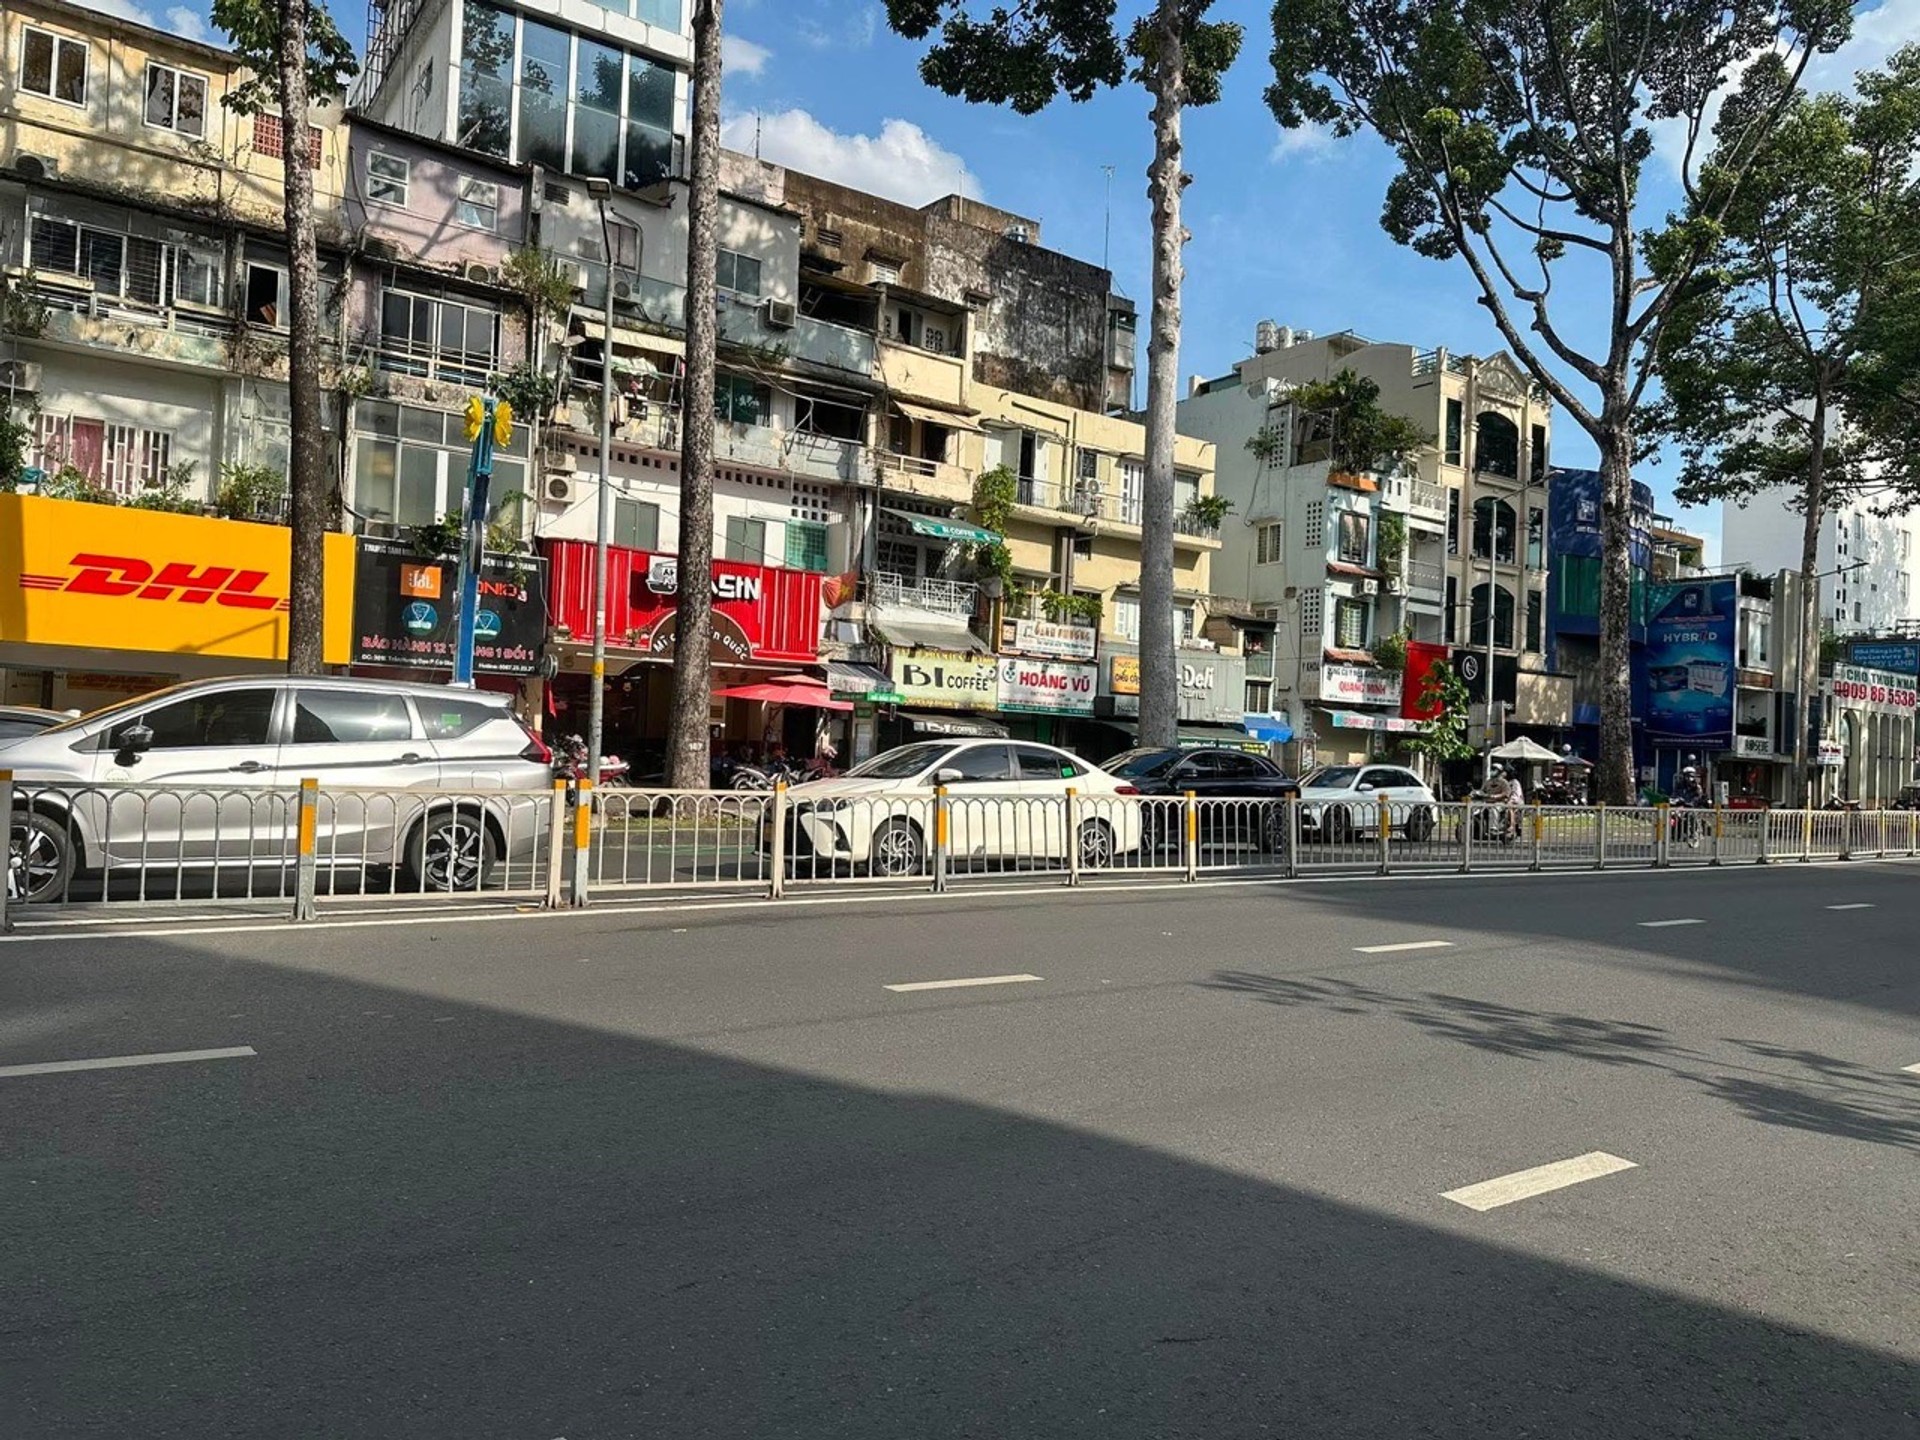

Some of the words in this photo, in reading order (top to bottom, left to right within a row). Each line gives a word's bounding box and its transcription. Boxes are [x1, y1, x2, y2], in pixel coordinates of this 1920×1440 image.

[65, 553, 280, 610] DHL
[903, 664, 944, 687] BI
[947, 675, 989, 691] COFFEE
[1834, 681, 1867, 700] 0909
[1871, 687, 1885, 702] 86
[1888, 688, 1915, 708] 5538
